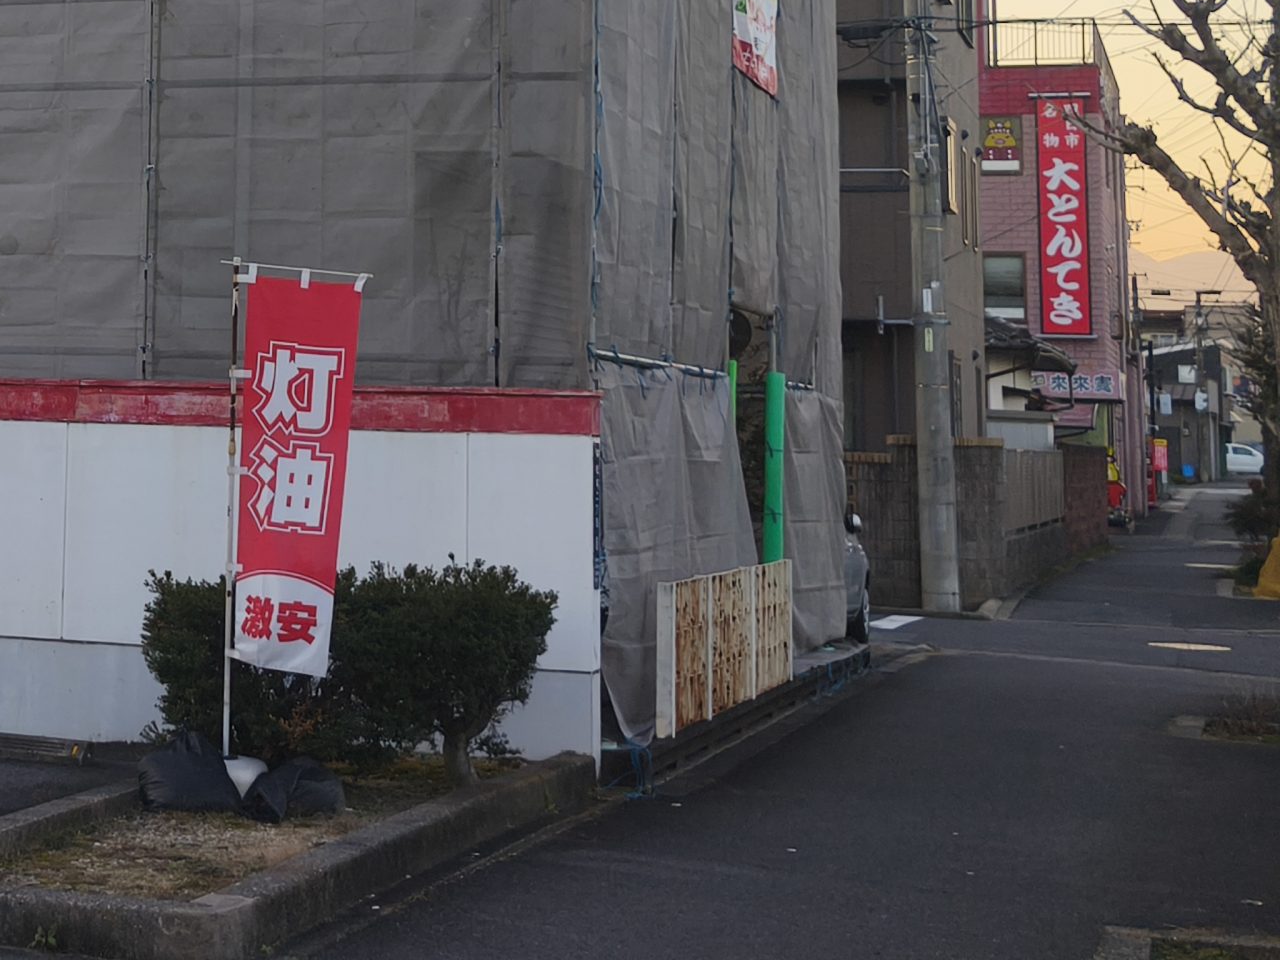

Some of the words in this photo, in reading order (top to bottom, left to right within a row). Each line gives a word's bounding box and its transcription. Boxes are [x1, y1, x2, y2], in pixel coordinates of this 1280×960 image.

[1043, 158, 1083, 325] 大とんてき
[248, 341, 345, 534] 灯油
[240, 595, 318, 646] 激安
